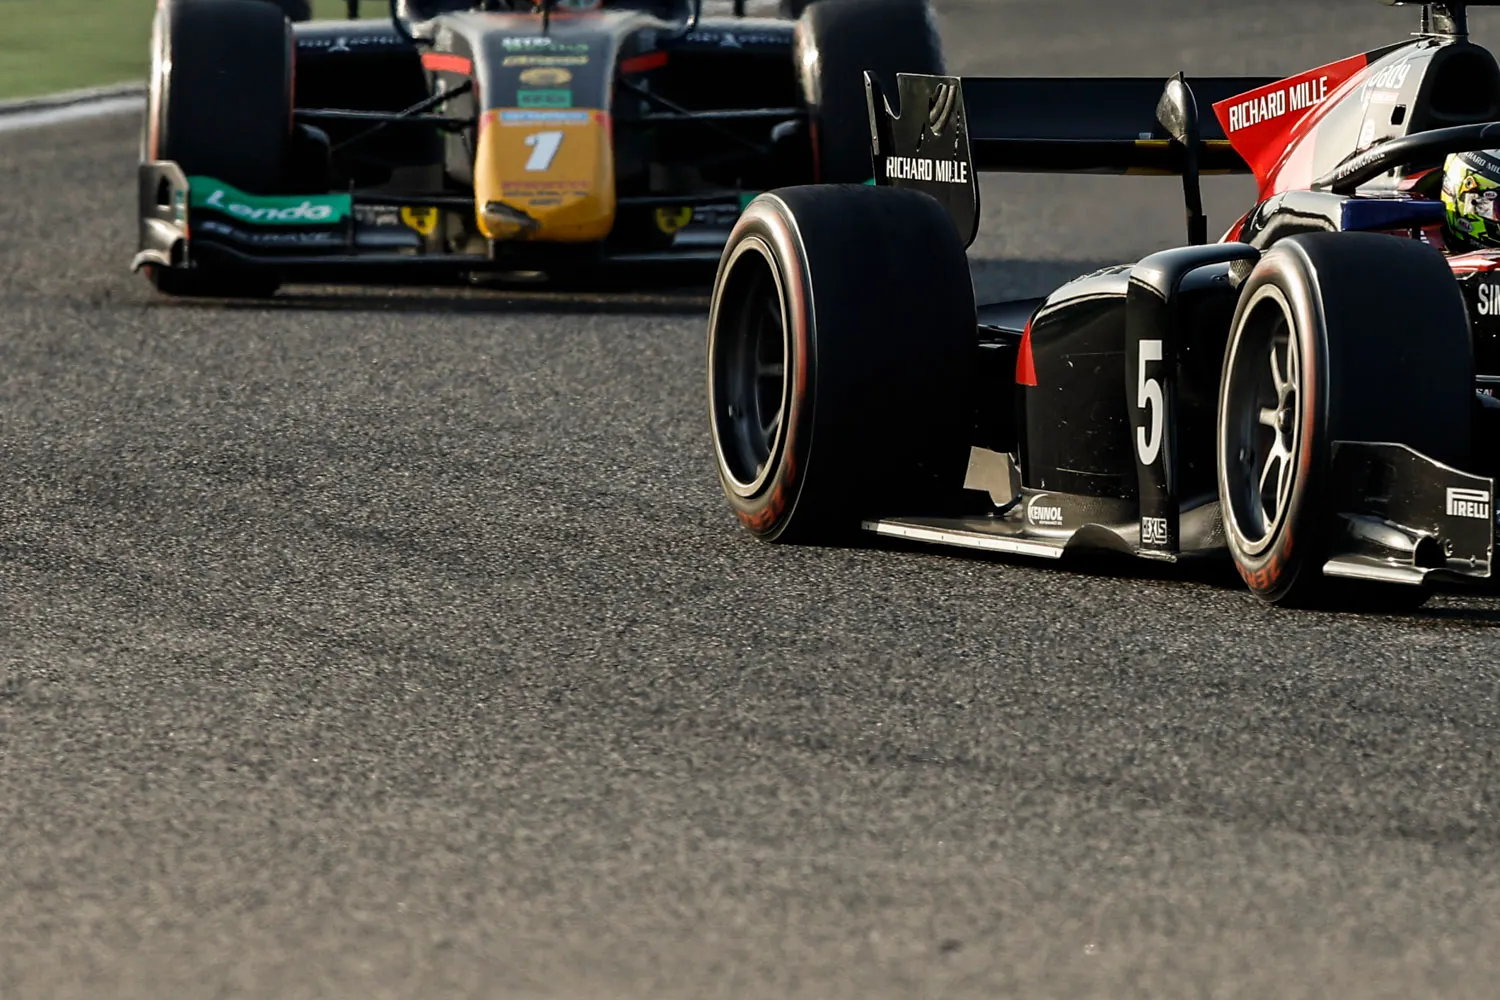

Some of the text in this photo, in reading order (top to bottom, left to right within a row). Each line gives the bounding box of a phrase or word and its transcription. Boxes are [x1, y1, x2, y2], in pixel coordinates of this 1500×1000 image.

[1229, 89, 1286, 132] RICHARD
[1289, 76, 1328, 112] MILLE
[524, 130, 564, 171] 1
[886, 156, 967, 183] RICHARD MILLE
[206, 190, 332, 220] Lendo
[1137, 340, 1163, 465] 5
[1030, 506, 1063, 521] KENNOL
[1446, 487, 1490, 519] PIRELLI
